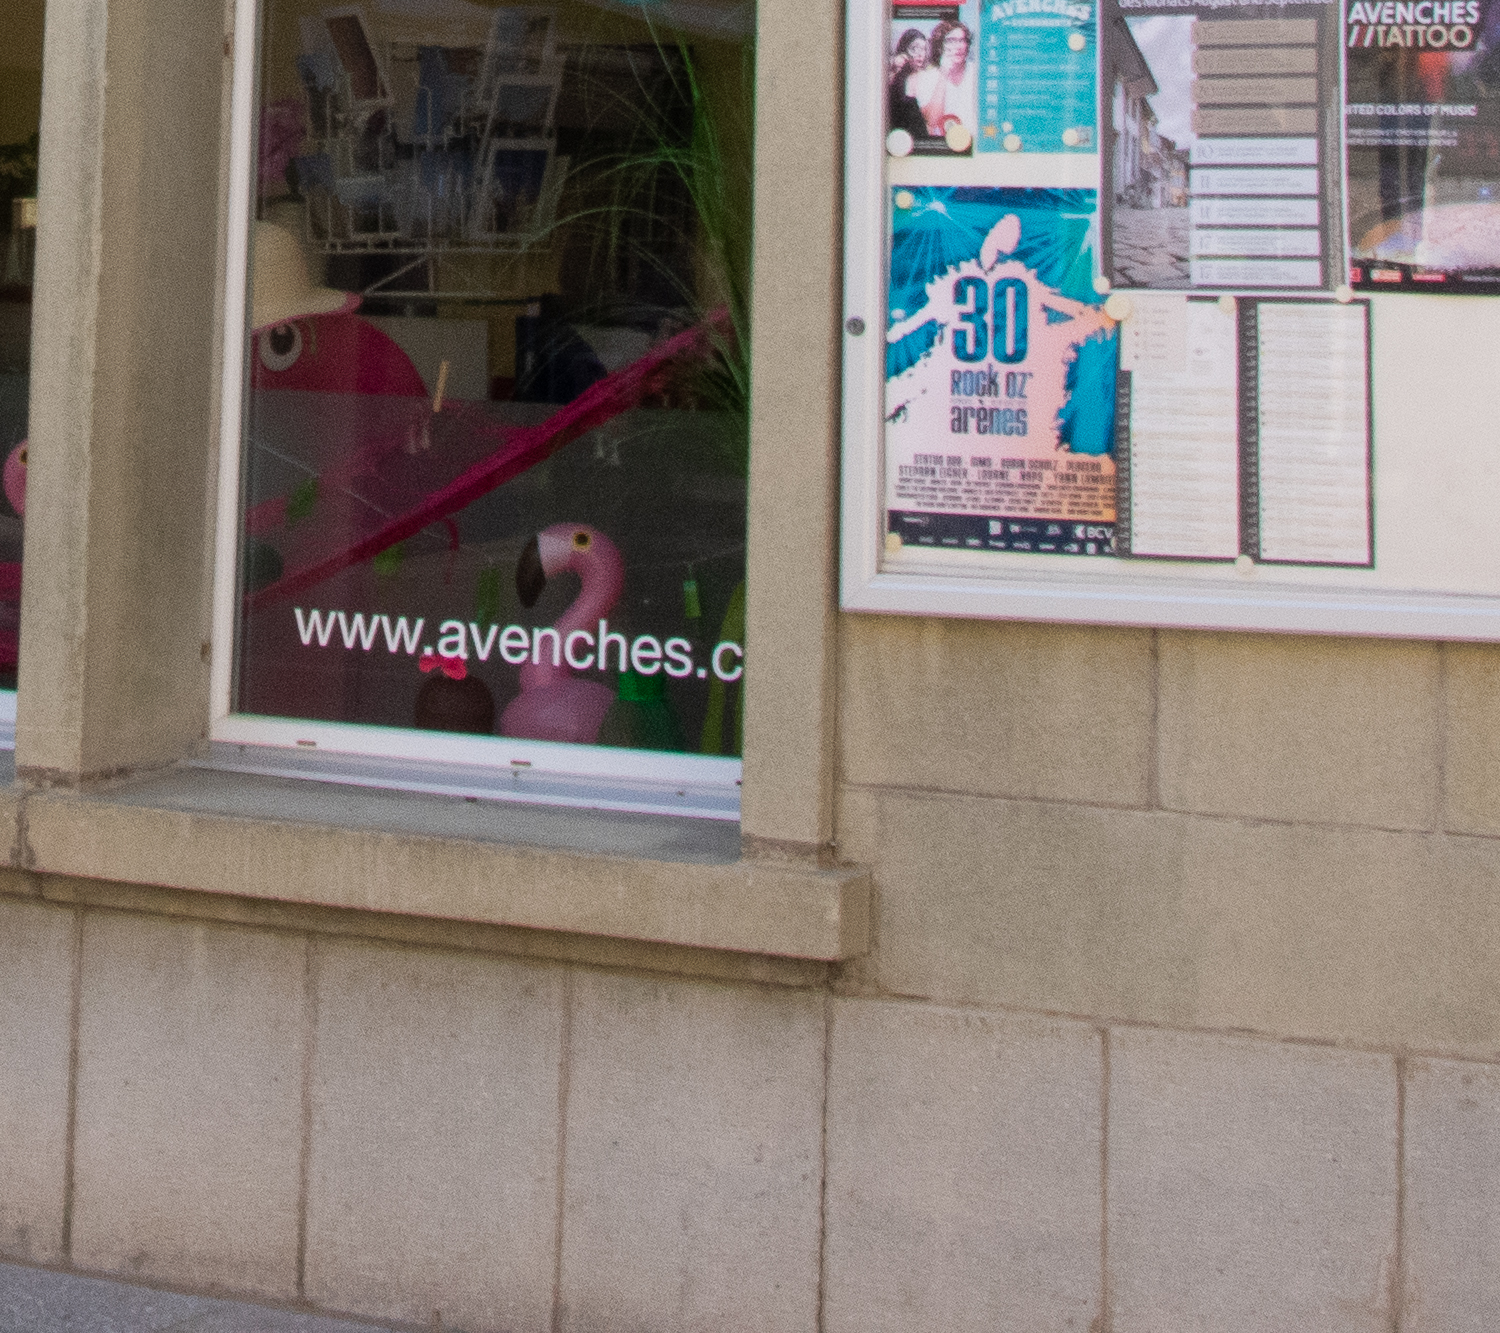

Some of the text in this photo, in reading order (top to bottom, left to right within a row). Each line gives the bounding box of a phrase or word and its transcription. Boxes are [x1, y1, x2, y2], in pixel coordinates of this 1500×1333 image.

[1348, 0, 1480, 24] AVENCHES
[1376, 104, 1421, 115] COLORS
[1423, 104, 1437, 115] OF
[1440, 104, 1477, 115] MUSIC
[953, 276, 1028, 364] 30
[951, 400, 1028, 436] arènes
[1086, 527, 1113, 540] BCV
